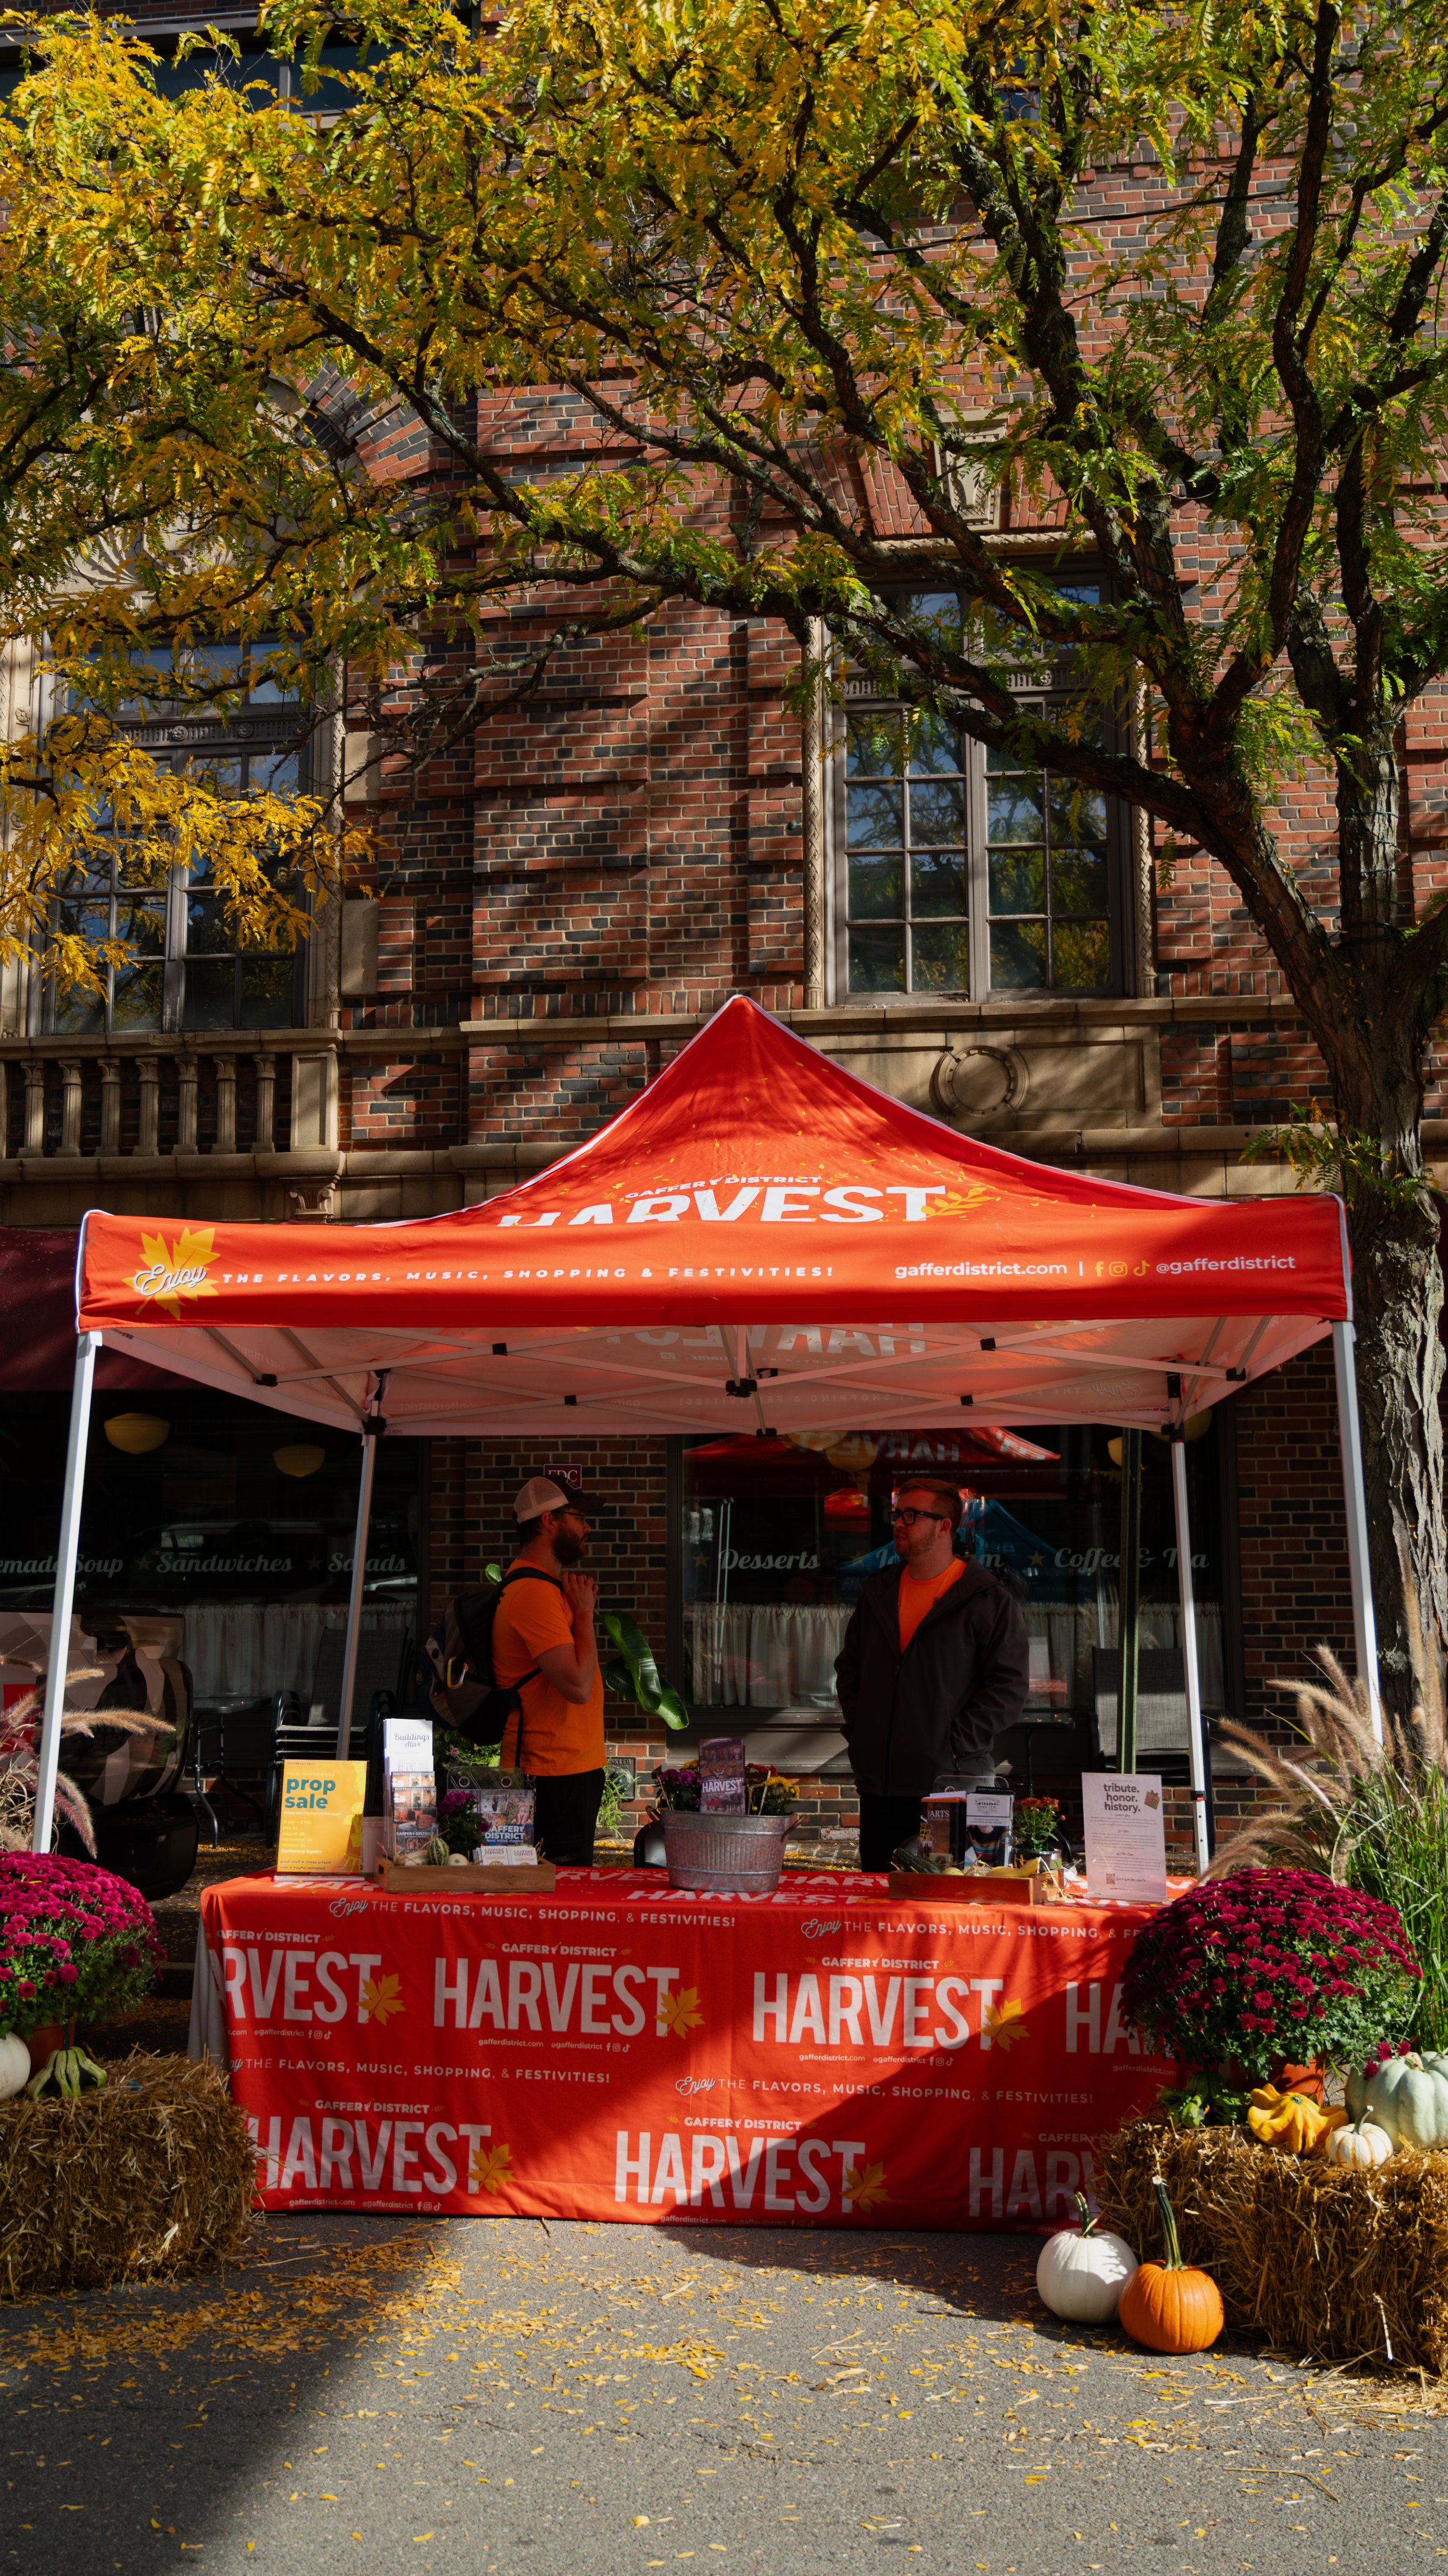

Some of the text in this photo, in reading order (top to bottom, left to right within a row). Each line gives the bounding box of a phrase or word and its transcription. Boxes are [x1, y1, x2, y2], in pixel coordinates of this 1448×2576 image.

[895, 1262, 1067, 1279] gafferdistrict.com
[1156, 1255, 1296, 1274] @gafferdistrict
[134, 1265, 834, 1297] Enjoy THE FLAVORS, MUSIC, SHOPPING & FESTIVITIES!
[156, 1552, 296, 1573] Sandwiches
[327, 1552, 408, 1573] Saads
[717, 1548, 821, 1570] Desserts
[1054, 1547, 1210, 1574] Coffee & Ta
[394, 1733, 430, 1742] Buildings
[286, 1778, 336, 1795] prop
[702, 1779, 741, 1793] HARVEST
[1103, 1783, 1140, 1793] tribute.
[284, 1793, 328, 1809] sale
[1106, 1793, 1138, 1802] honor.
[930, 1810, 950, 1818] ARTS
[1105, 1802, 1141, 1814] history.
[626, 1890, 866, 1905] HARVEST
[329, 1898, 736, 1928] Enjoy THE FLAVORS, MUSIC, SHOPPING, & FESTIVITIES!
[800, 1918, 842, 1939] Enjoy
[844, 1921, 873, 1932] THE
[878, 1923, 953, 1936] FLAVORS,
[959, 1924, 1012, 1938] MUSIC,
[1017, 1925, 1102, 1939] SHOPPING,
[1109, 1928, 1118, 1939] &
[265, 1931, 321, 1944] DISTRICT
[560, 1945, 617, 1957] DISTRICT
[881, 1958, 939, 1970] DISTRICT
[433, 1956, 680, 2037] HARVEST
[753, 1972, 1004, 2051] HARVEST
[254, 2029, 305, 2037] @gafferdistrict
[478, 2037, 603, 2051] gafferdistrict.com @gafferdistrict
[799, 2052, 926, 2065] gafferdistrict.com @gafferdistrict
[246, 2058, 273, 2069] THE
[279, 2059, 350, 2074] FLAVORS,
[356, 2062, 408, 2077] MUSIC,
[414, 2065, 495, 2080] SHOPPING,
[501, 2069, 510, 2079] &
[515, 2069, 610, 2084] FESTIVITIES!
[1113, 2064, 1177, 2077] gafferdistrict.com
[675, 2076, 1094, 2104] Enjoy THE FLAVORS, MUSIC, SHOPPING, & FESTIVITIES!
[373, 2102, 430, 2114] DISTRICT
[744, 2118, 802, 2131] DISTRICT
[248, 2116, 492, 2195] HARVEST
[615, 2130, 866, 2213] HARVEST
[289, 2197, 414, 2210] gafferdistrict.com @gafferdistrict
[660, 2215, 787, 2227] gafferdistrict.com @gafferdistrict
